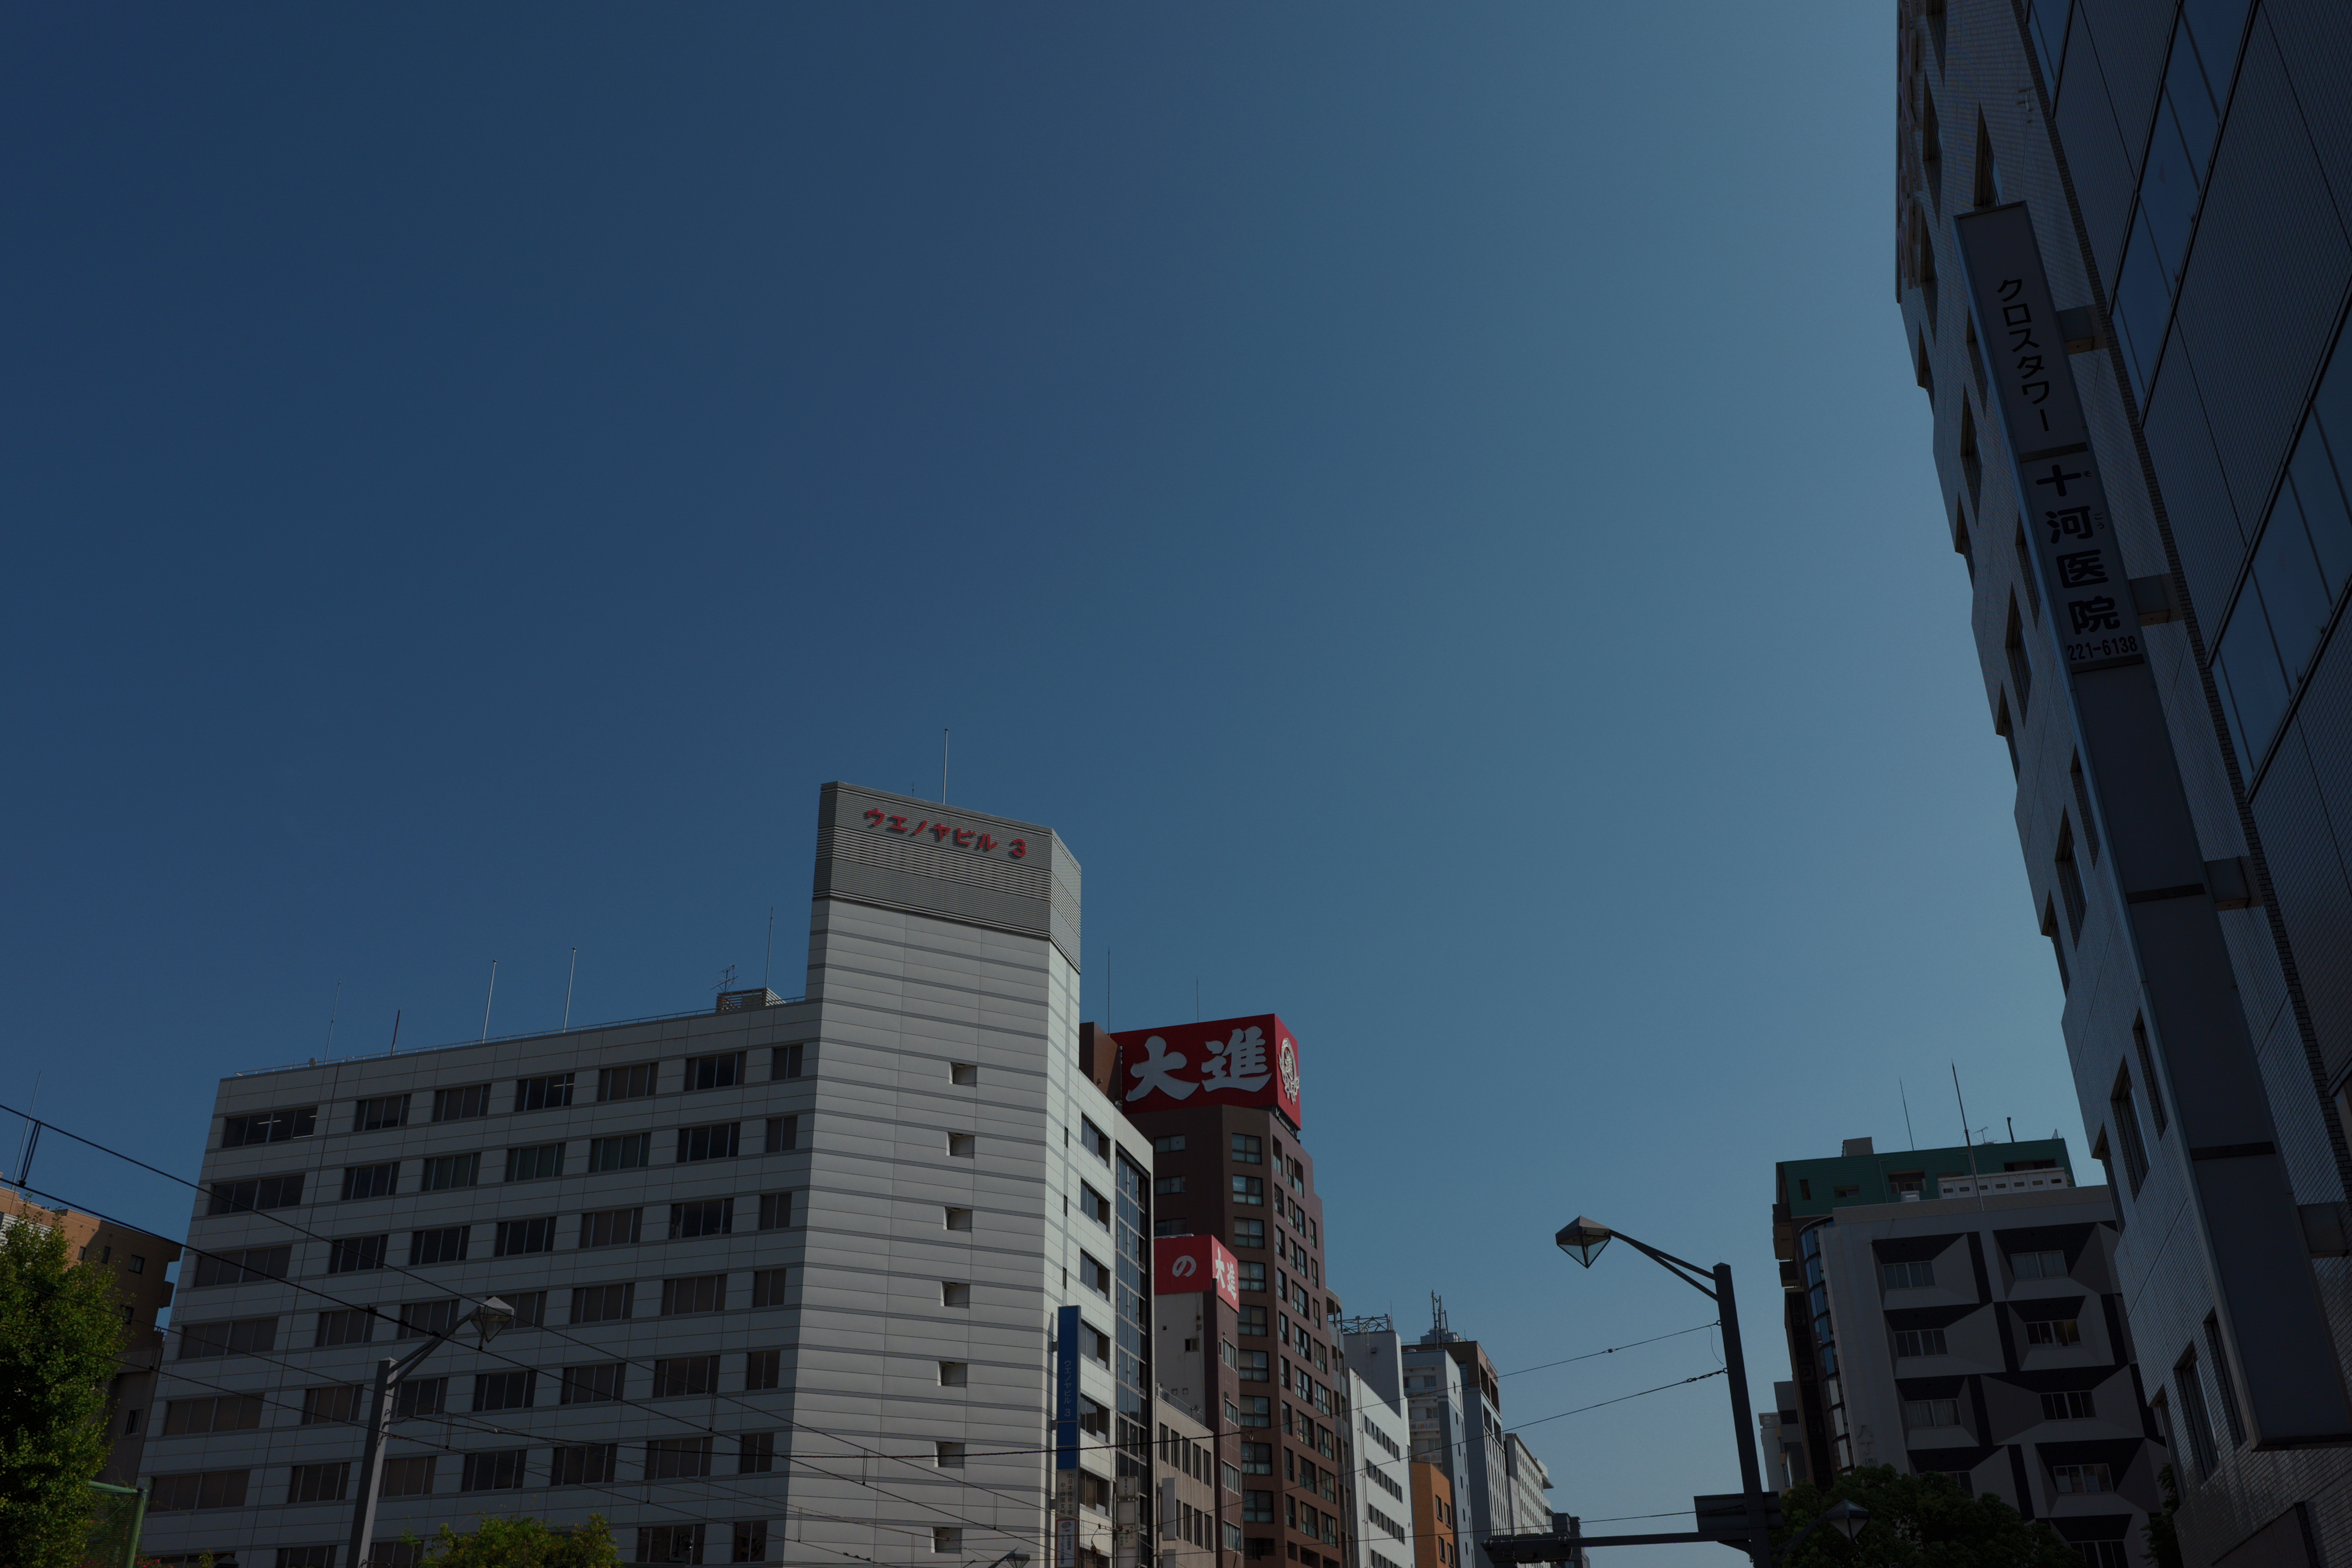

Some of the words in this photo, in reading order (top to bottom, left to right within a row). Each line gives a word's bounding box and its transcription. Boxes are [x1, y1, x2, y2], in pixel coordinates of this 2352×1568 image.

[1997, 279, 2049, 432] クロスタワー
[2036, 465, 2121, 635] 十河医院
[2067, 636, 2138, 661] 221-6138
[867, 808, 998, 850] ウエノヤビル
[1012, 838, 1026, 857] 3
[1125, 1025, 1273, 1102] 大進
[1172, 1255, 1197, 1278] の
[1215, 1246, 1237, 1301] 大進
[1063, 1359, 1072, 1404] ウエノヤビル
[1064, 1408, 1071, 1417] 3
